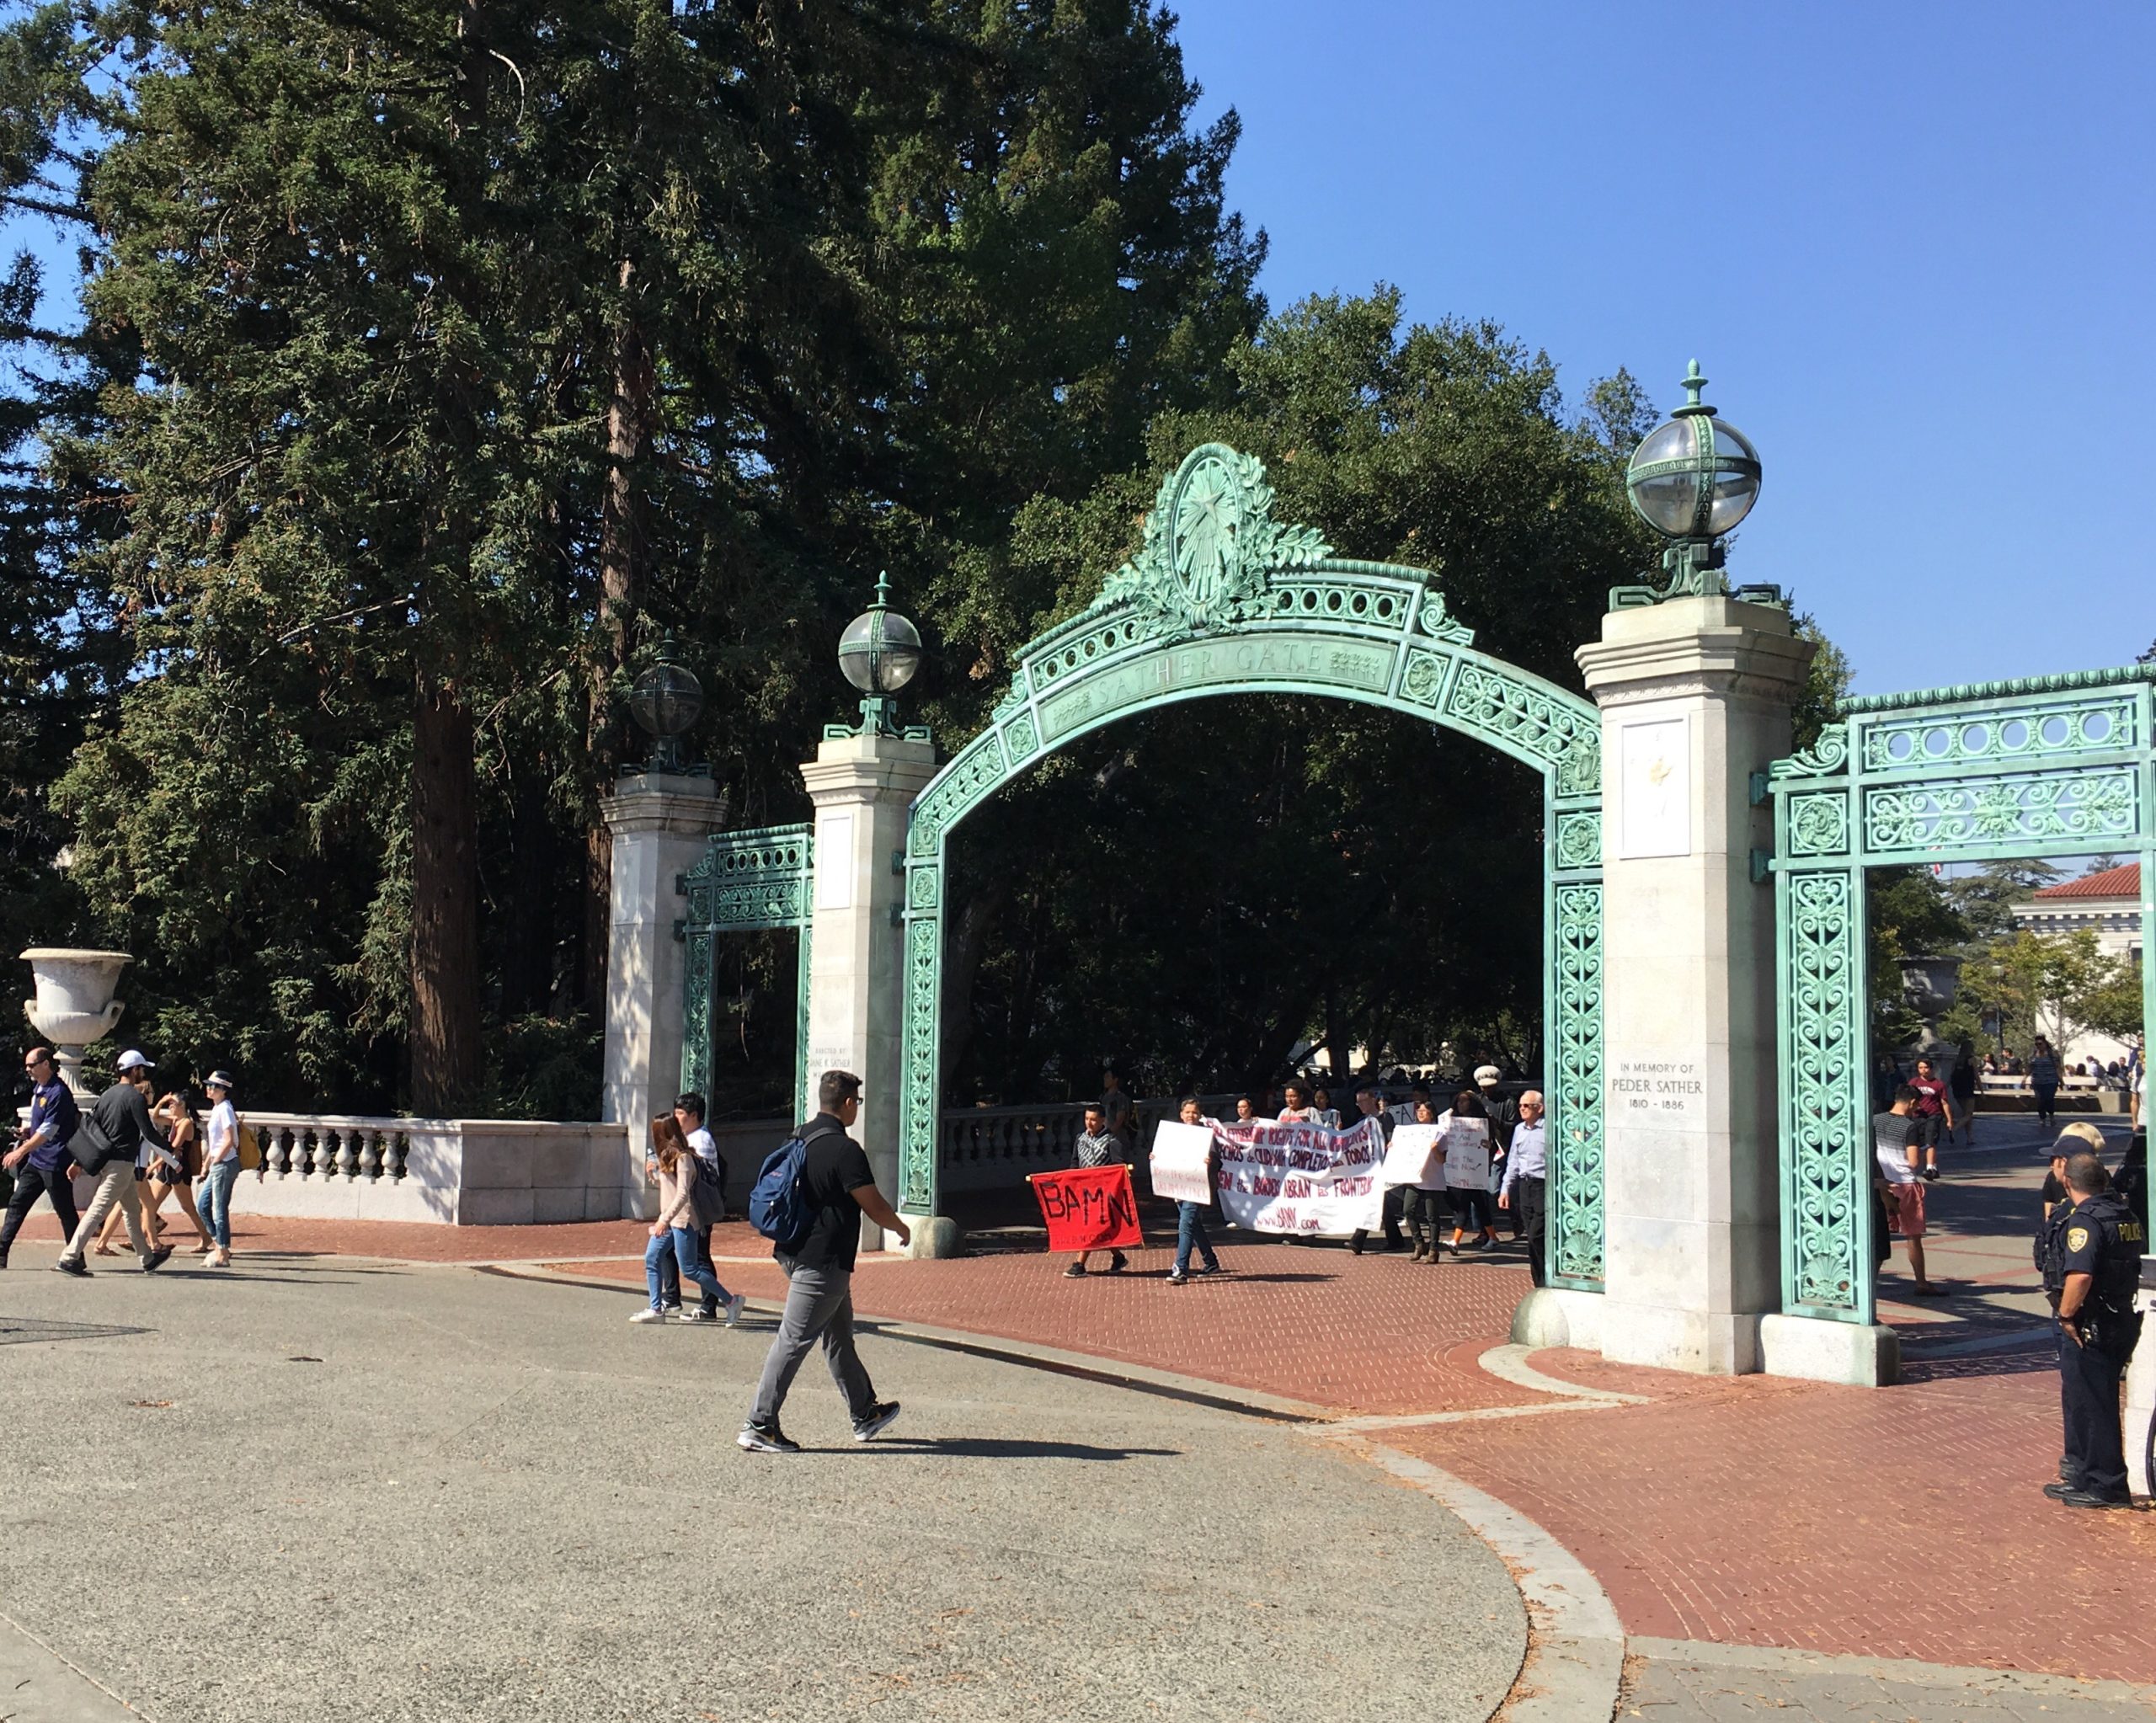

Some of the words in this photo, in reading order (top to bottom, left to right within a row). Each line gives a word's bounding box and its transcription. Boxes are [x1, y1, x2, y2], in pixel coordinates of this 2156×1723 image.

[1098, 650, 1214, 704] SATHER
[1236, 643, 1322, 672] GATE
[1620, 1063, 1630, 1072] IN
[1634, 1063, 1676, 1074] MEMORY
[1679, 1064, 1694, 1074] OF
[1612, 1079, 1652, 1092] PEDER
[1656, 1080, 1703, 1094] SATHER
[1629, 1099, 1648, 1108] 1810
[1662, 1101, 1684, 1110] 1886
[1267, 1127, 1294, 1145] RIGHTS
[1294, 1128, 1311, 1148] FOR
[1313, 1130, 1327, 1151] ALL
[1236, 1177, 1248, 1192] the
[1283, 1177, 1311, 1199] ABRAN
[1038, 1181, 1134, 1229] BAMN
[2117, 1222, 2143, 1241] POLICE
